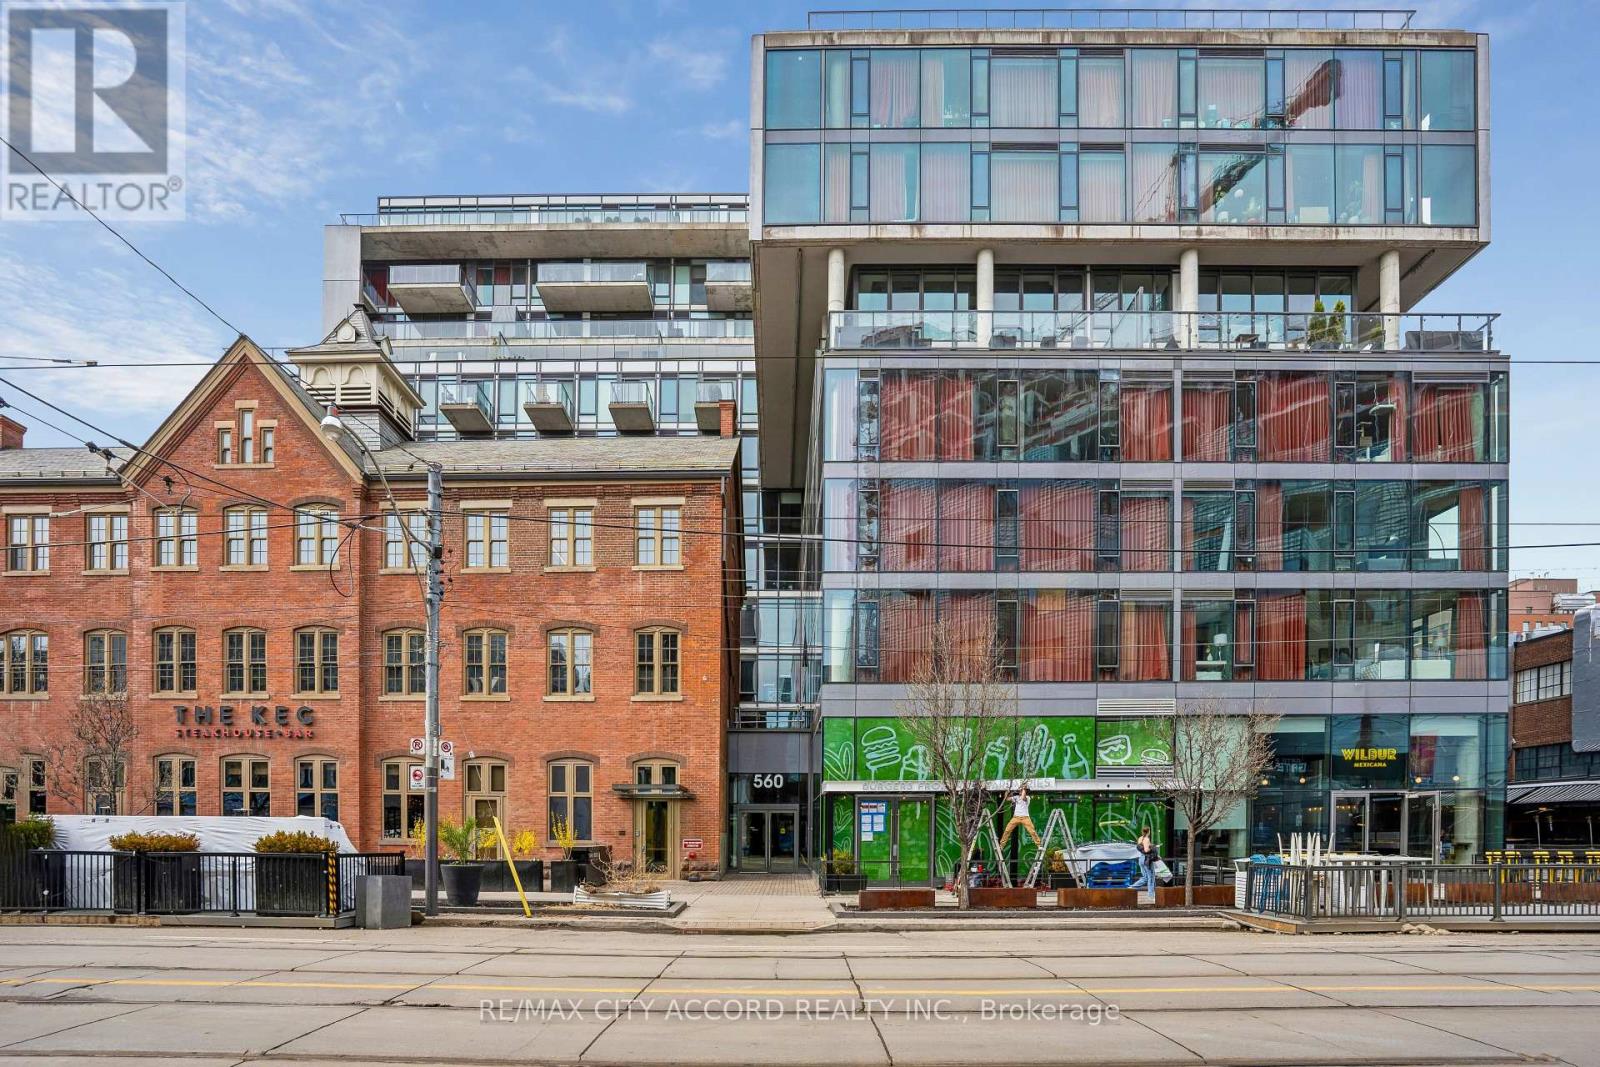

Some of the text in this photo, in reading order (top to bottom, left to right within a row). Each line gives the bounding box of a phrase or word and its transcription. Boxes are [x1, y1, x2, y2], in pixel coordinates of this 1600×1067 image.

[173, 705, 315, 726] THE KEG
[1341, 748, 1398, 761] WILBUR
[1353, 761, 1388, 769] MEXICANA
[752, 773, 785, 789] 560
